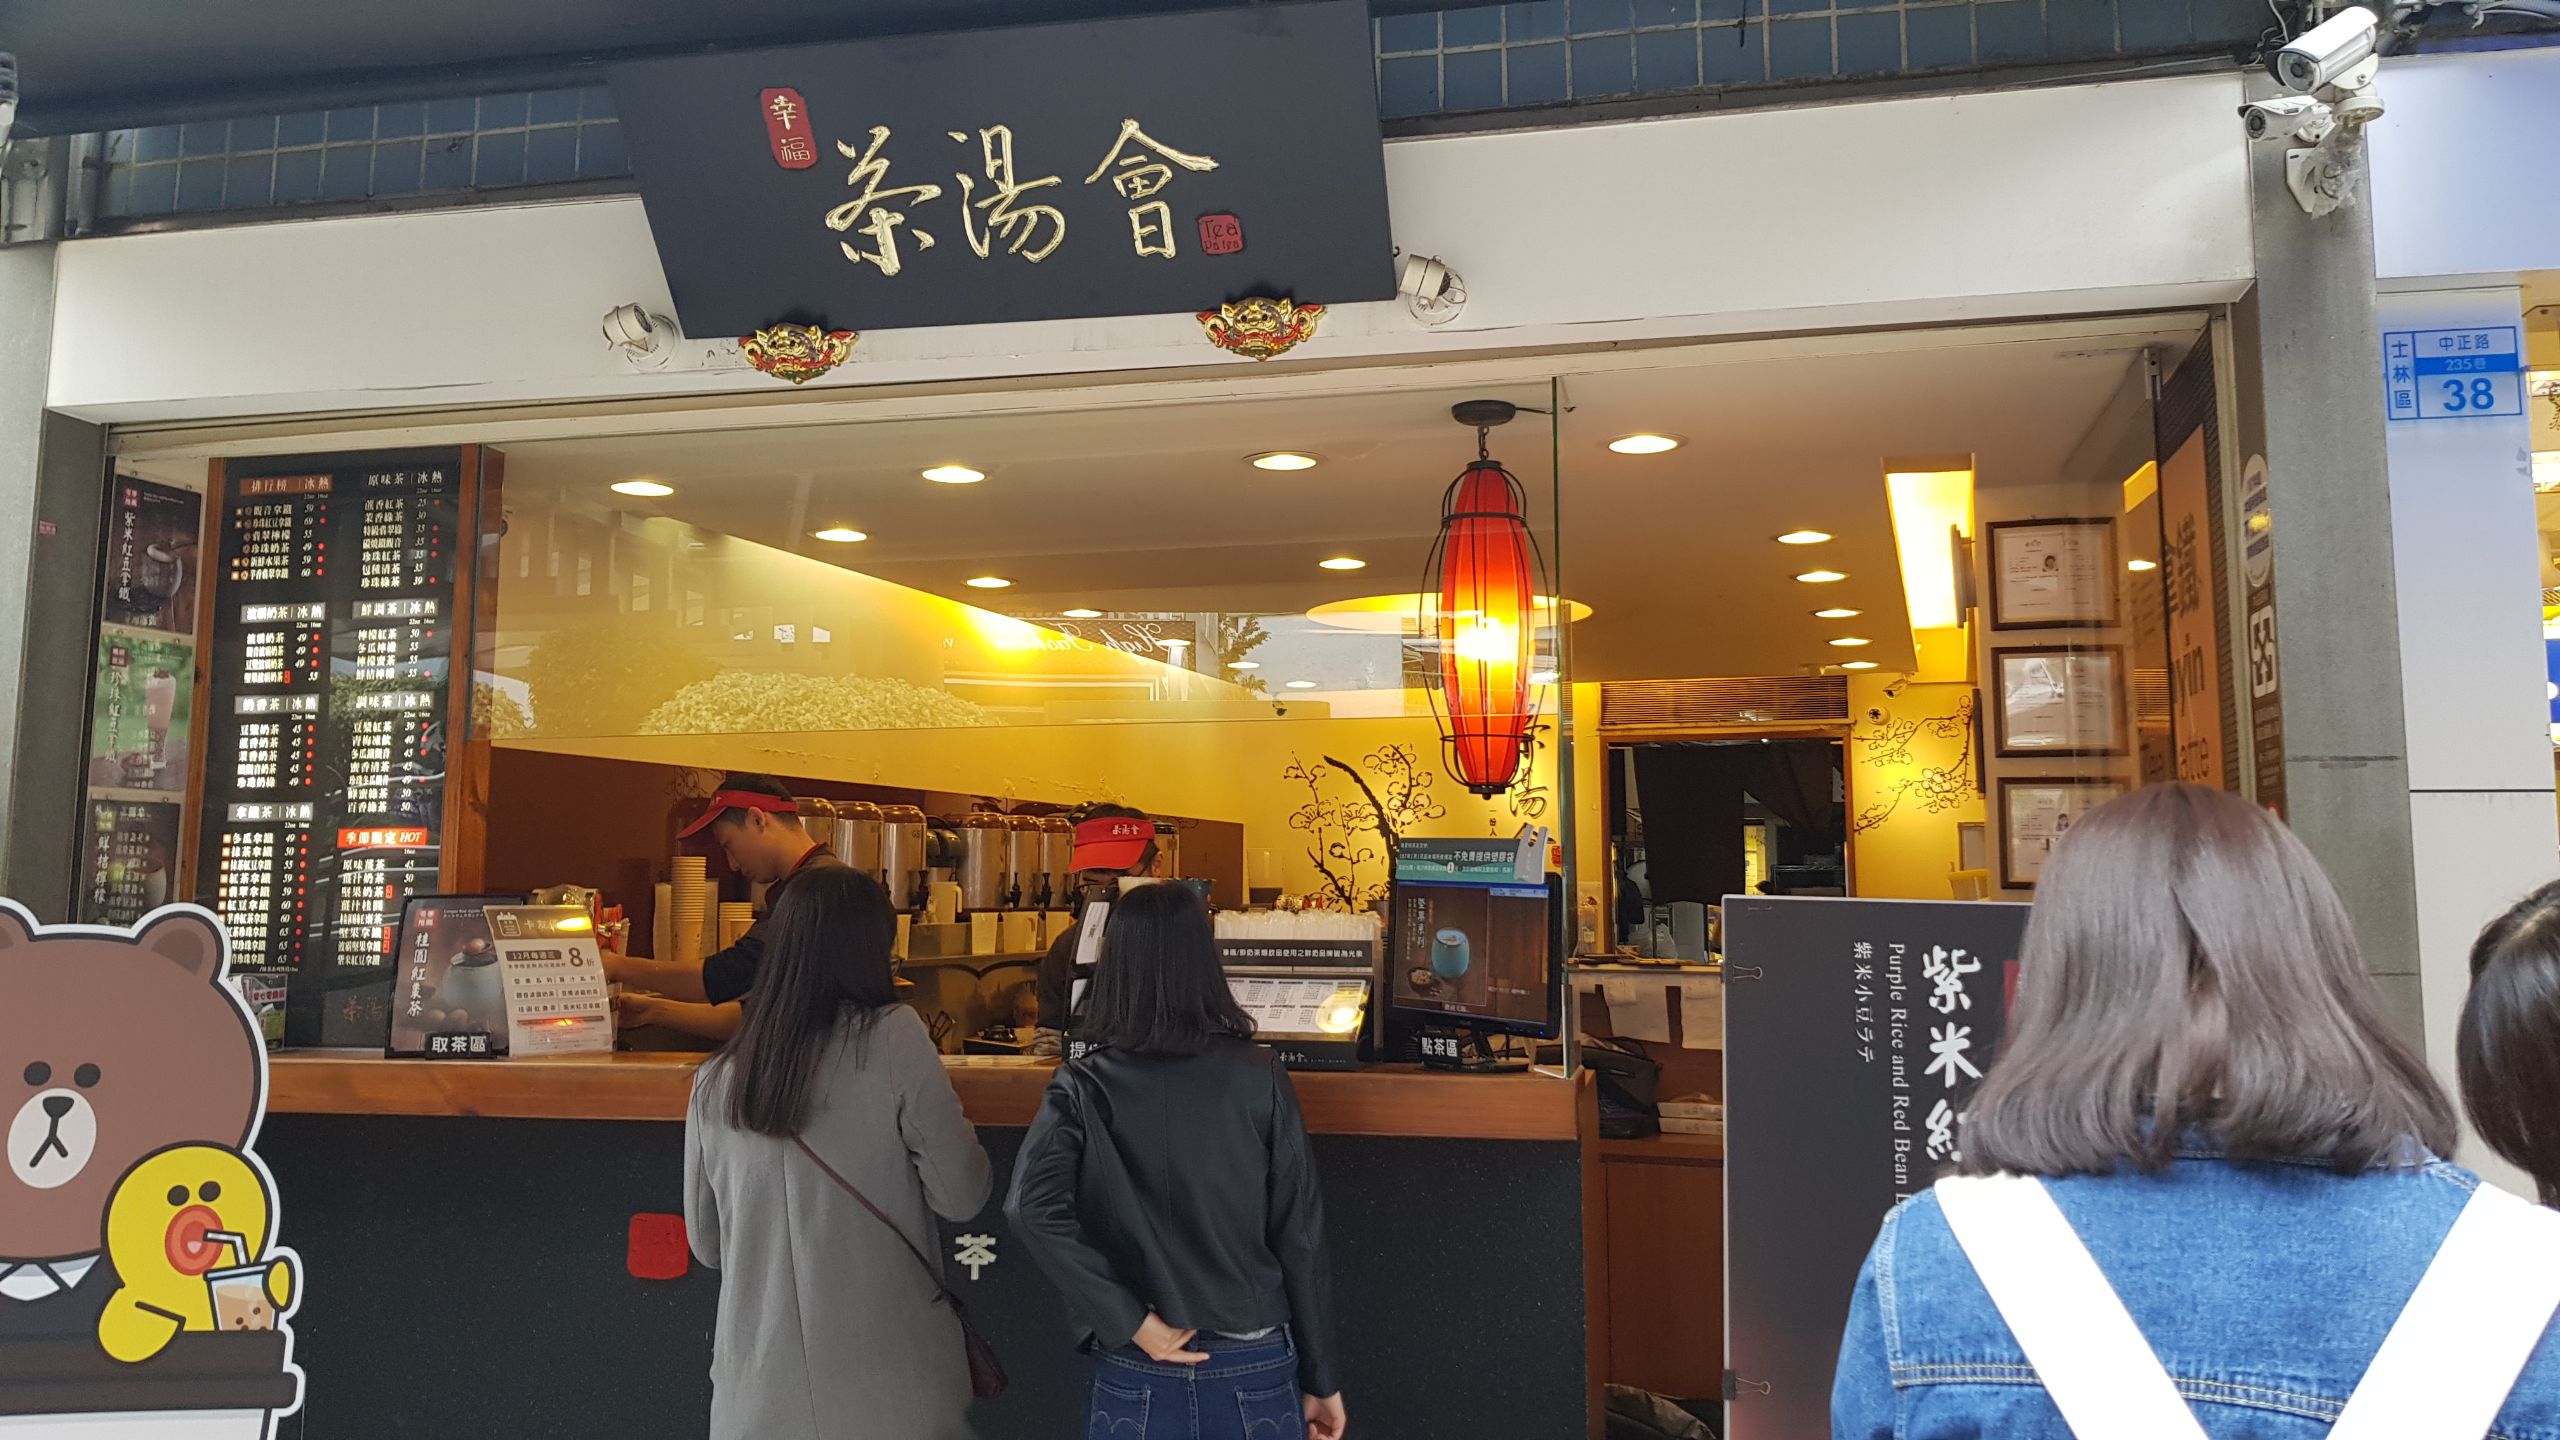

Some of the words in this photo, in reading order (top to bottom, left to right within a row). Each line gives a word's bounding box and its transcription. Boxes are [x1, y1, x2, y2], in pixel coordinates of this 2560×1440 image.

[769, 95, 811, 164] 幸福
[825, 118, 1219, 276] 茶湯會
[1202, 218, 1238, 238] Tea
[2439, 334, 2489, 351] 中正路
[2391, 340, 2412, 408] 士林區
[2443, 377, 2494, 411] 38
[251, 479, 287, 492] 排行榜
[305, 478, 314, 490] 冰
[368, 473, 404, 486] 原味茶
[418, 471, 428, 484] 冰
[301, 568, 310, 577] 60
[298, 607, 307, 618] 冰
[410, 601, 420, 613] 冰
[292, 697, 302, 710] 冰
[286, 806, 296, 817] 冰
[400, 832, 422, 842] HOT
[1453, 851, 1514, 862] 不免費提供塑膠袋
[568, 948, 583, 967] 8
[407, 932, 429, 1016] 桂圓紅棗茶
[1887, 943, 1906, 1002] Purple
[1853, 941, 1875, 1063] 紫米小豆ラテ
[1889, 1008, 1907, 1050] Rice
[432, 1035, 487, 1053] 取茶區
[1421, 1035, 1458, 1059] 點茶區
[1892, 1056, 1909, 1088] and
[1892, 1094, 1910, 1131] Red
[1894, 1139, 1912, 1184] Bean
[954, 1233, 998, 1280] 茶
